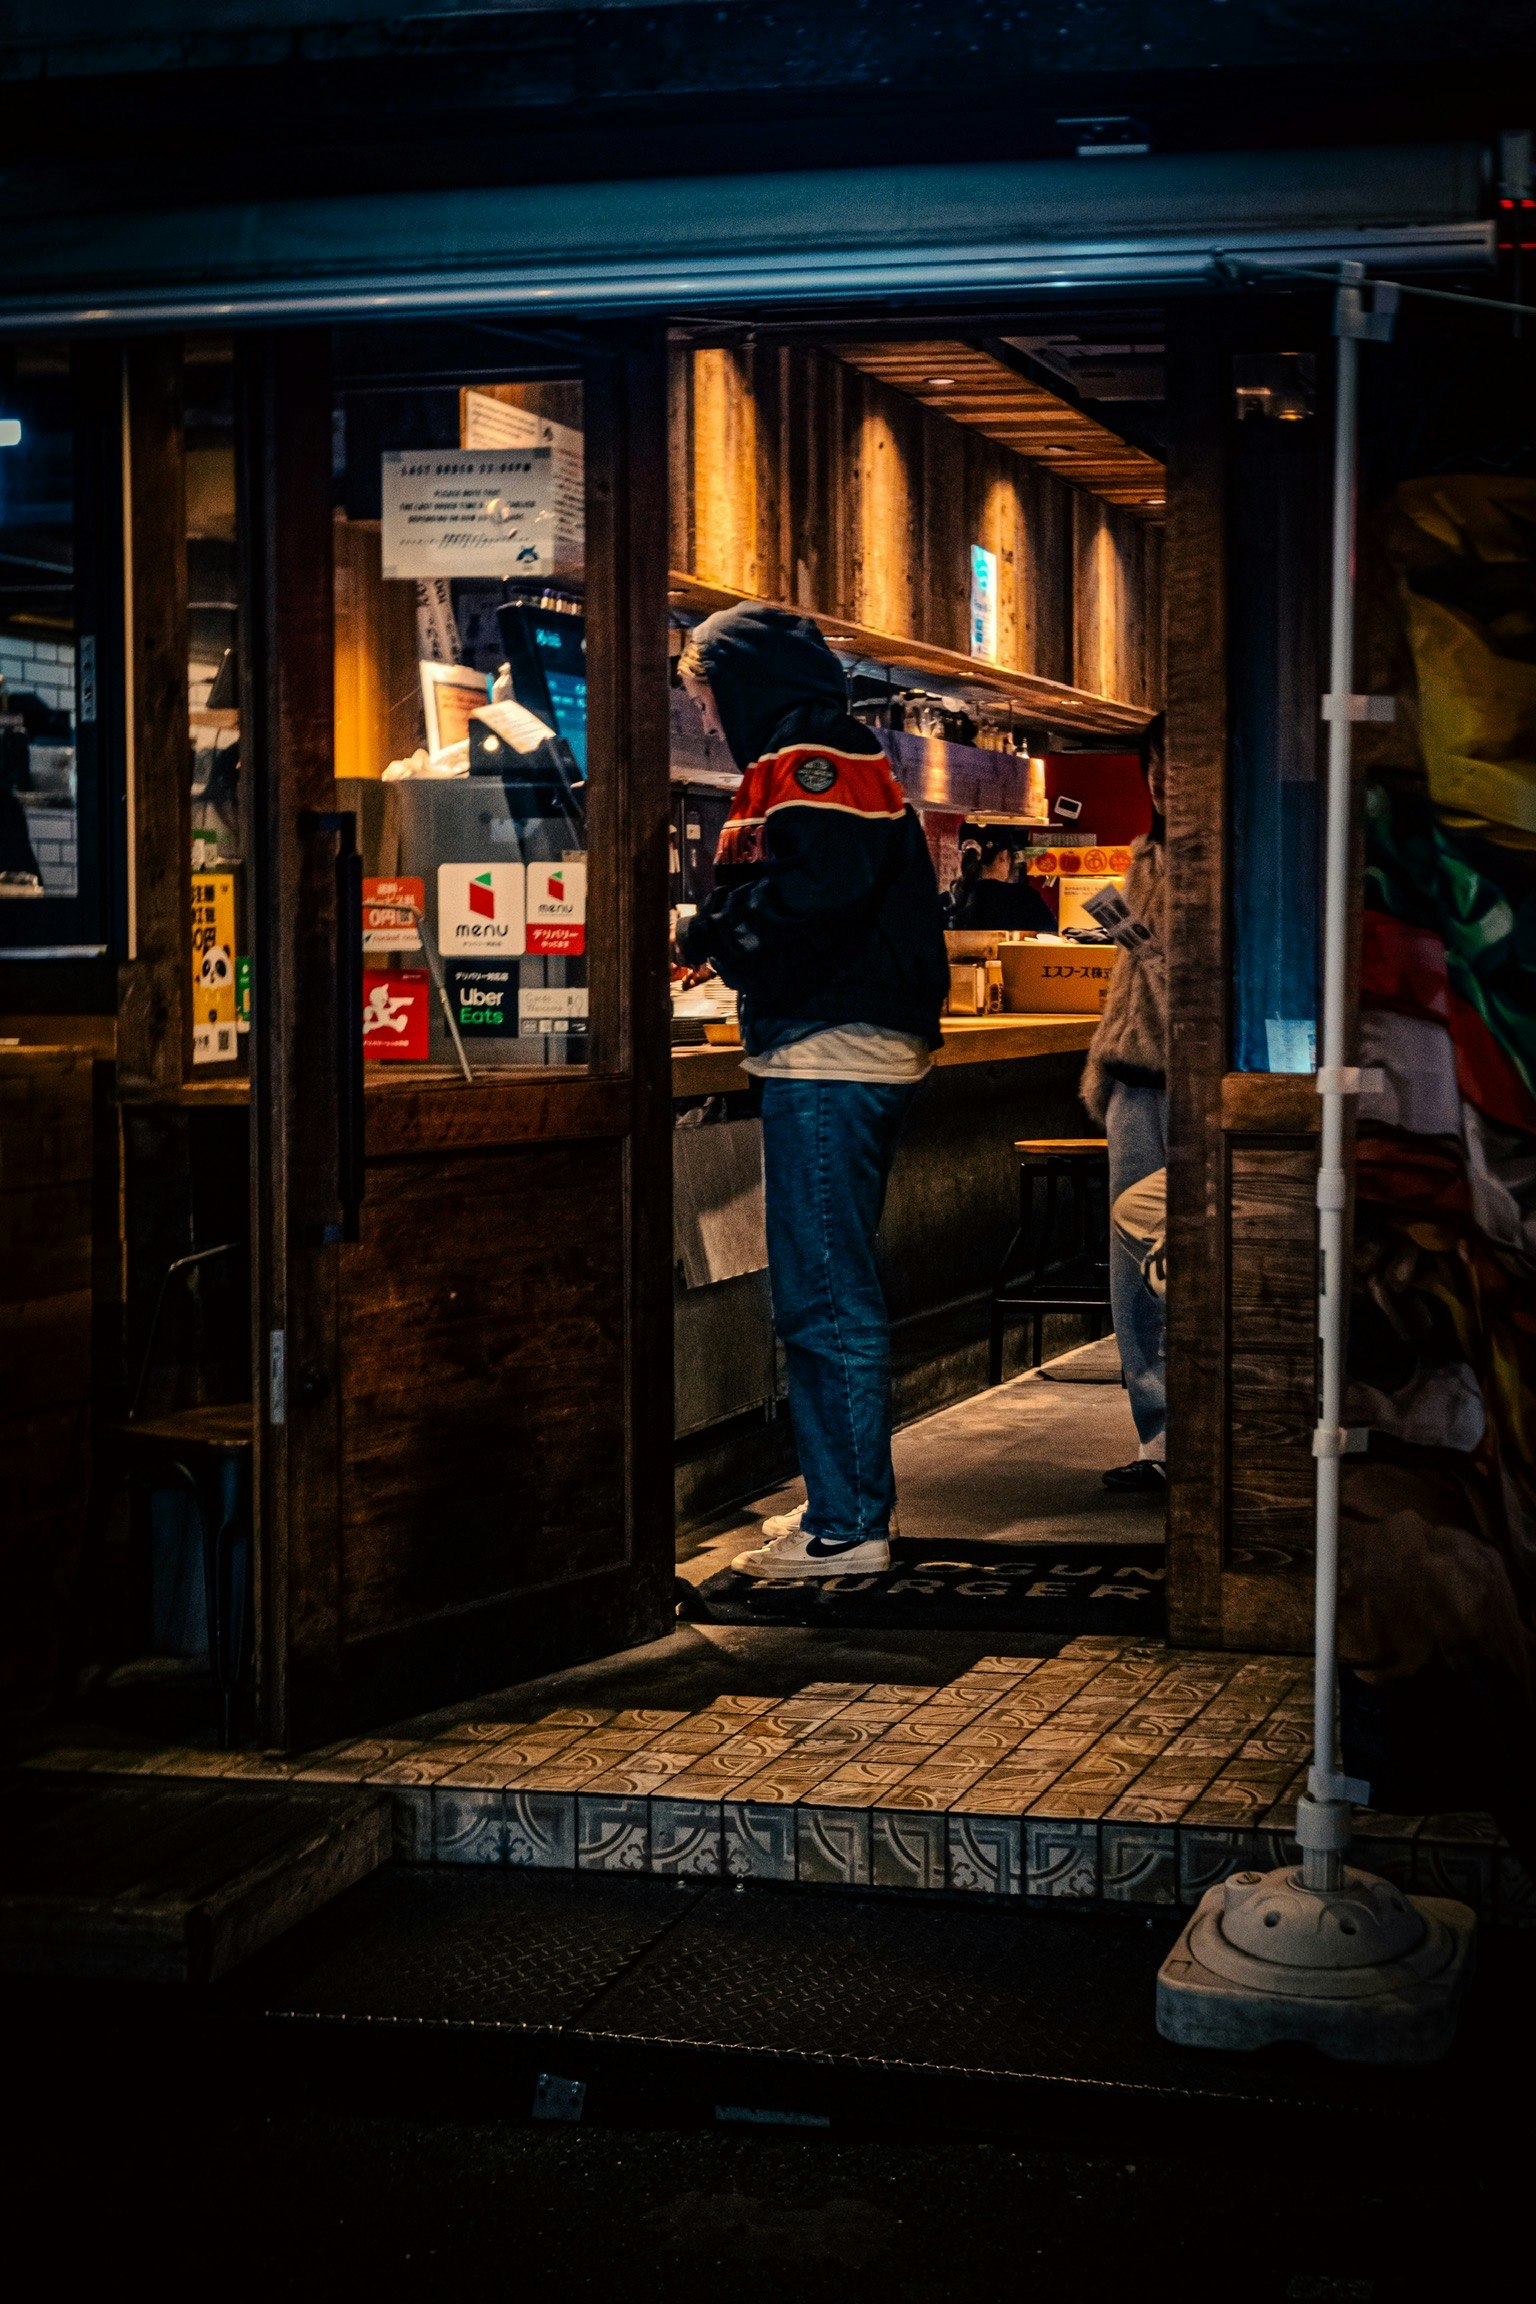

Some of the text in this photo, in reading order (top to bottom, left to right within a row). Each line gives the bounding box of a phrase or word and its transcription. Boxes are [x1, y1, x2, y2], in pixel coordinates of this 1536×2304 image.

[538, 904, 573, 913] menu
[456, 924, 508, 937] menu
[533, 929, 579, 940] デリバリー
[460, 988, 504, 1006] Uber
[460, 1007, 504, 1024] Eats
[751, 1577, 1152, 1600] BURGER
